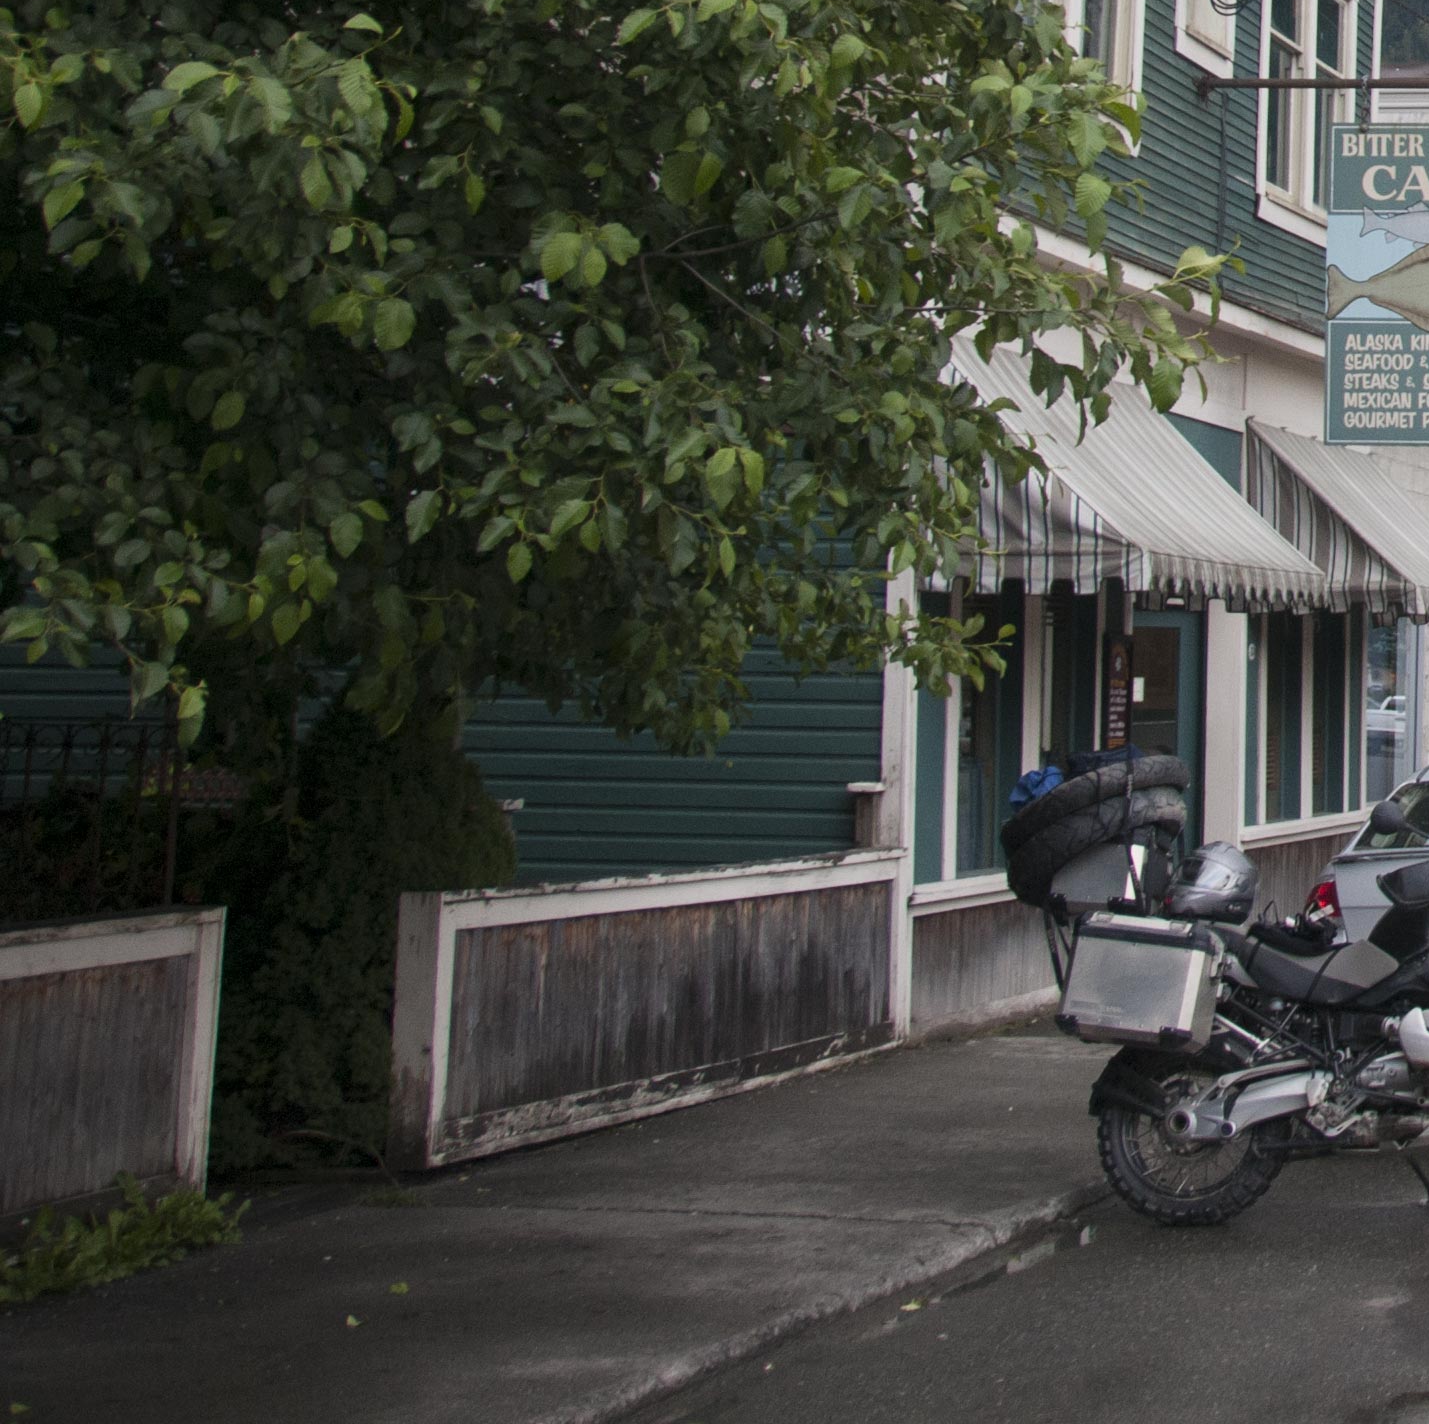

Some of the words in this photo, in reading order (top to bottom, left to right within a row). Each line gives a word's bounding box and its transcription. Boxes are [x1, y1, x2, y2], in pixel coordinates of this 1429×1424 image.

[1342, 133, 1425, 157] BITTER
[1344, 334, 1403, 351] ALASKA
[1344, 354, 1414, 371] SEAFOOD
[1419, 355, 1429, 369] &
[1343, 373, 1399, 390] STEAKS
[1406, 376, 1416, 388] &
[1343, 392, 1411, 409] MEXICAN
[1343, 411, 1417, 429] GOURMET
